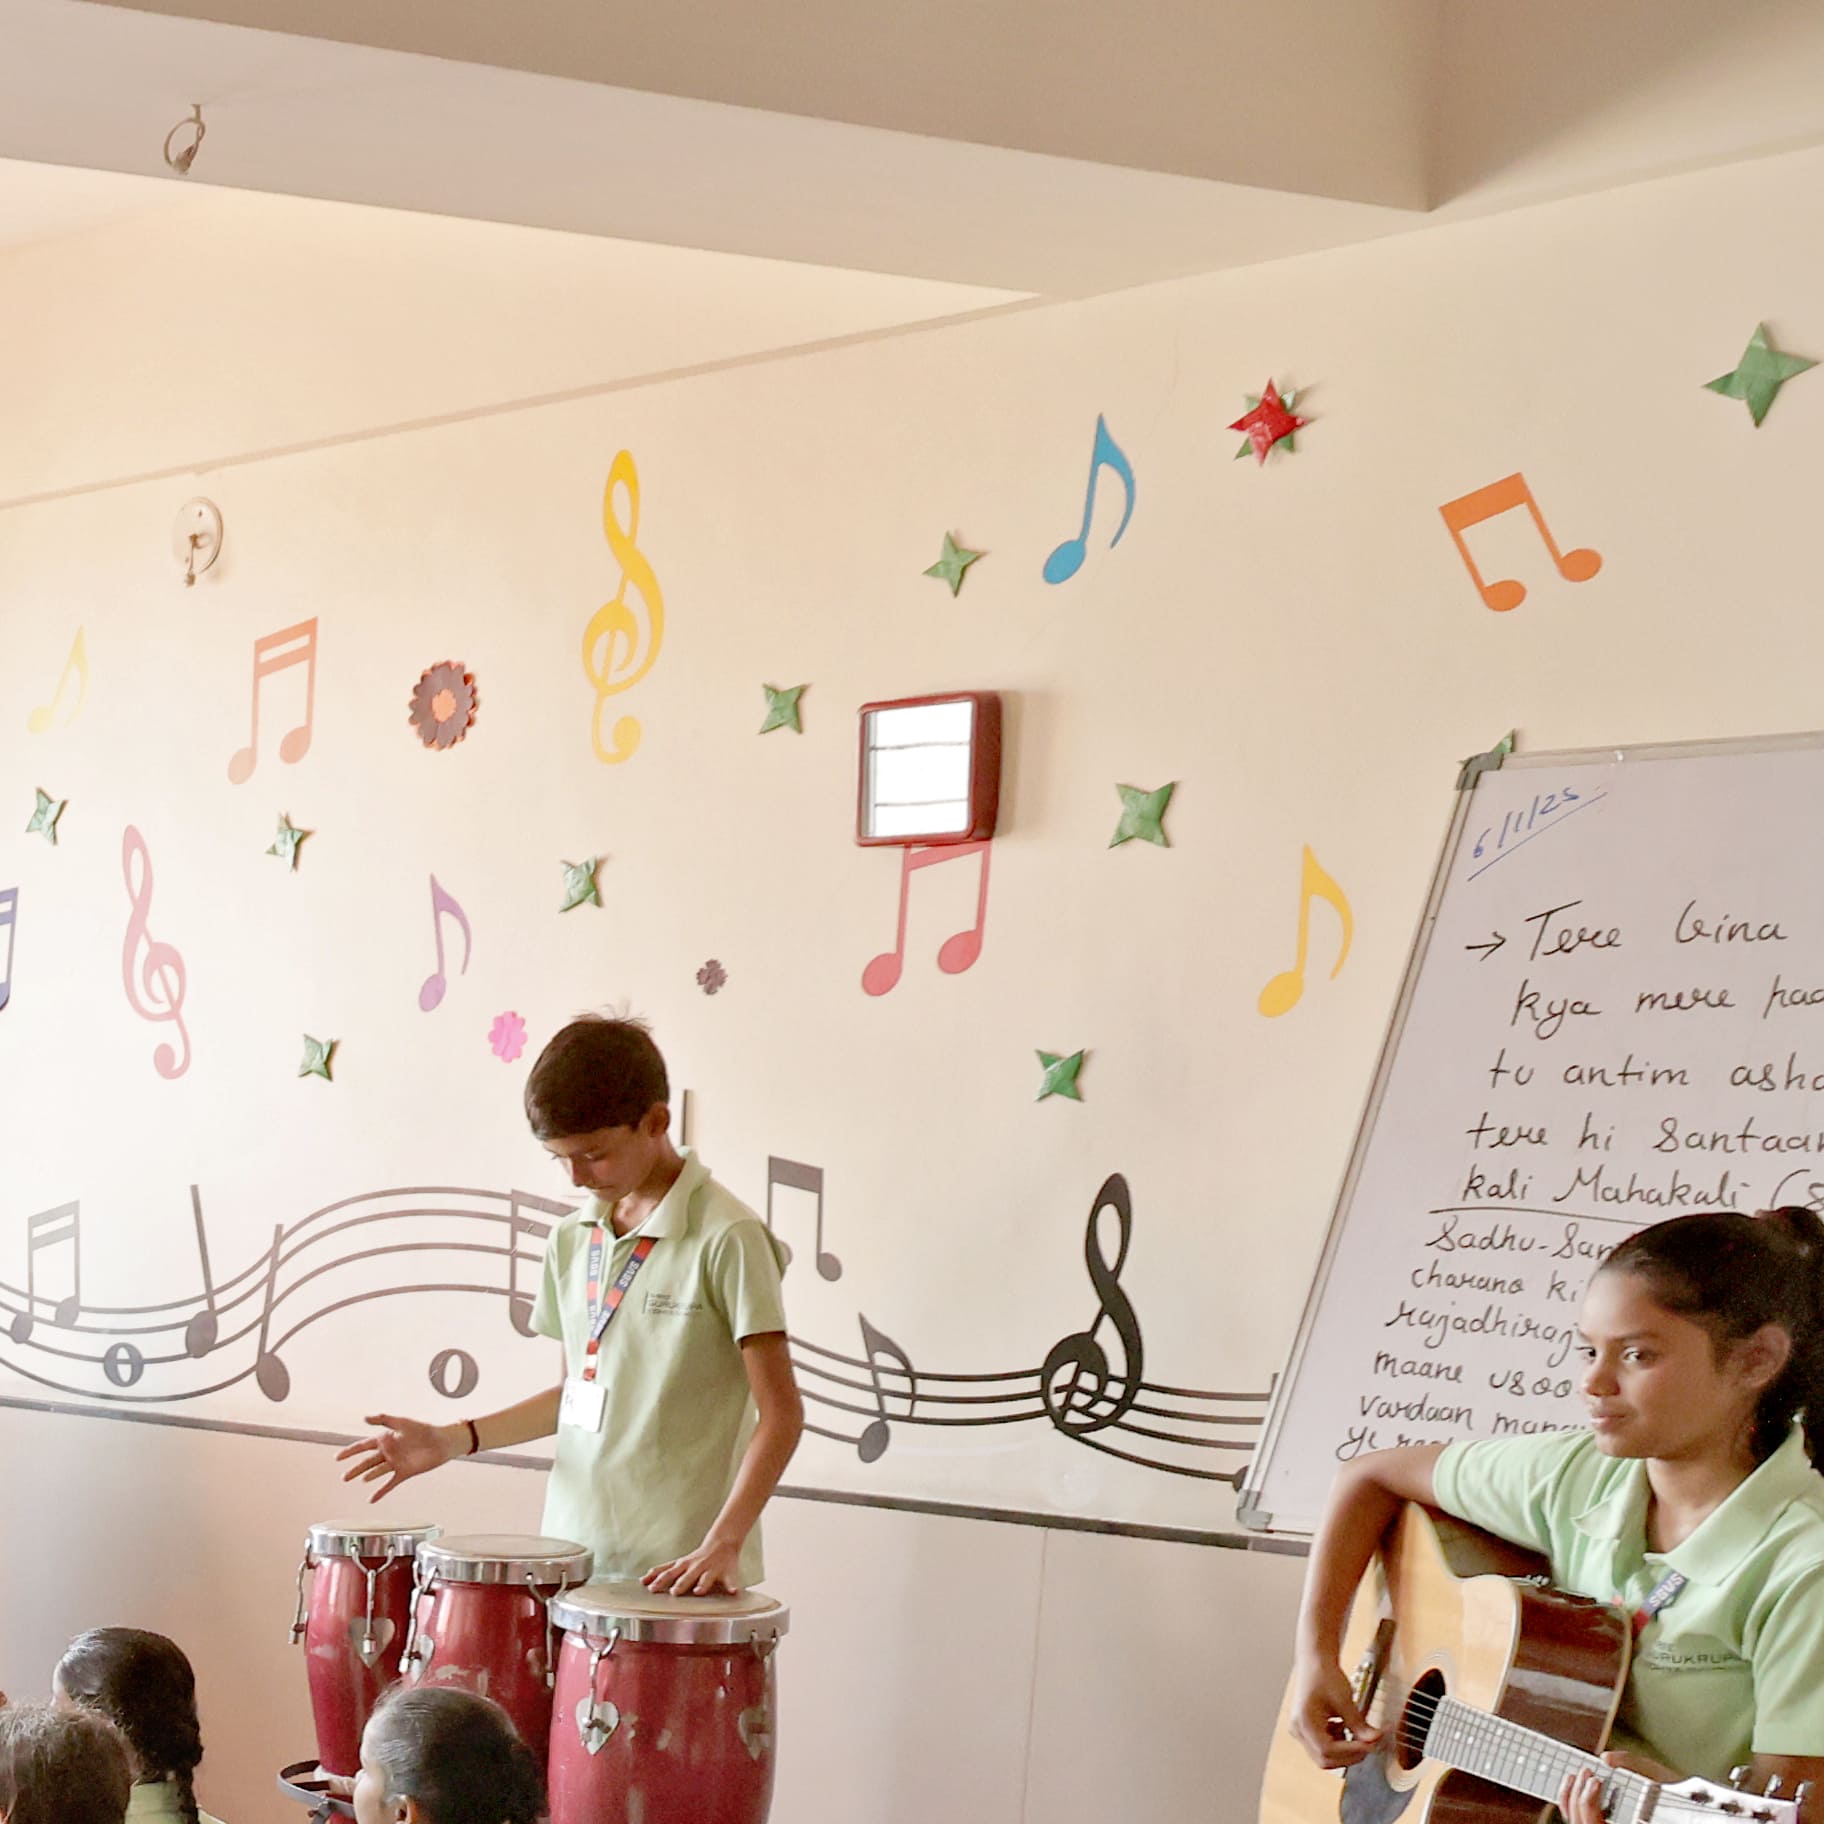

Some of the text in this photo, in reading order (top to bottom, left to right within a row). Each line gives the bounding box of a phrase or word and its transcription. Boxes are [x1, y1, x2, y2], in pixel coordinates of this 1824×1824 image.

[1524, 899, 1623, 961] Tere
[1634, 986, 1737, 1014] mere
[1562, 1053, 1690, 1088] antim
[1465, 1111, 1549, 1150] tere
[1577, 1111, 1616, 1151] hi
[1546, 1270, 1584, 1302] ki
[1373, 1349, 1463, 1384] maane
[1648, 1572, 1685, 1608] SGVS
